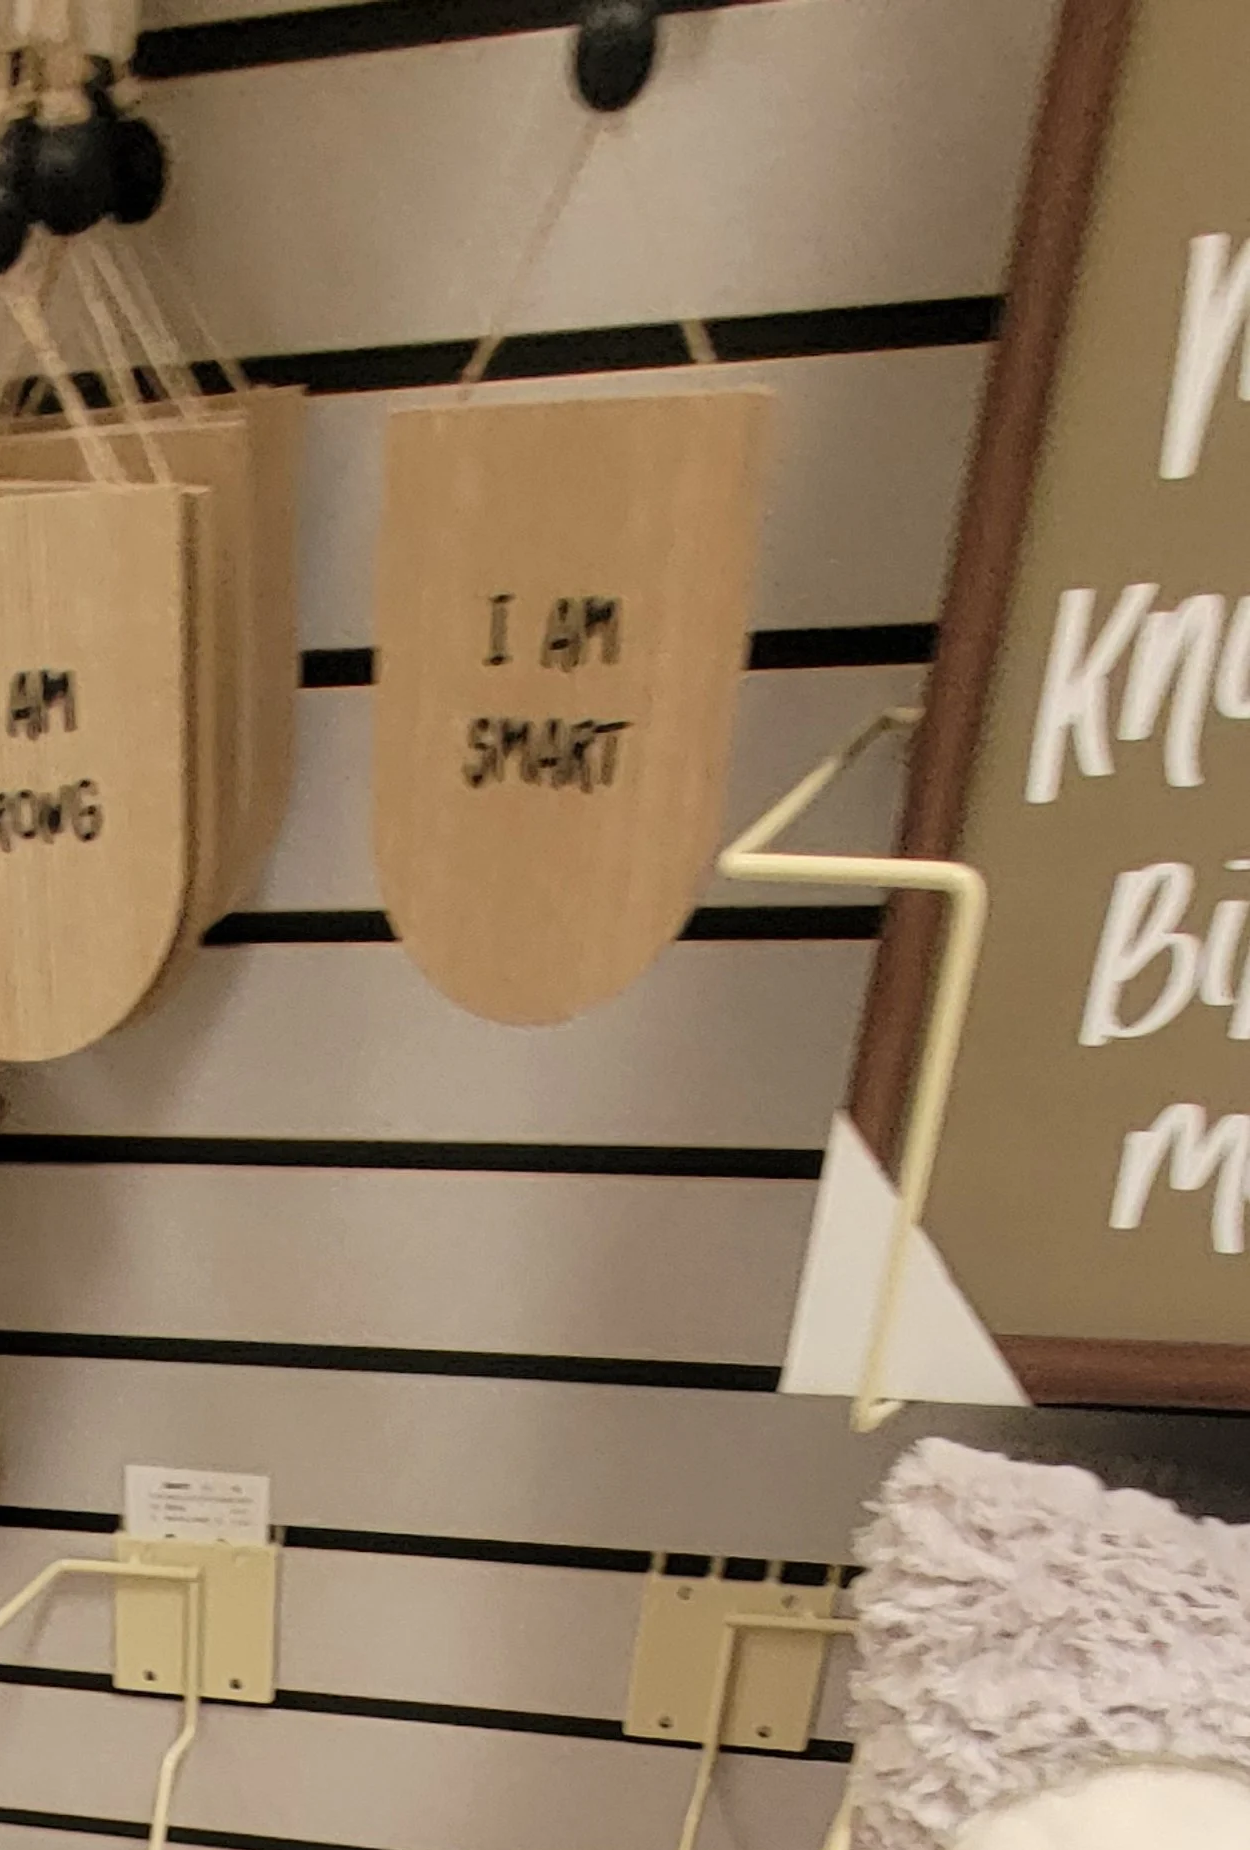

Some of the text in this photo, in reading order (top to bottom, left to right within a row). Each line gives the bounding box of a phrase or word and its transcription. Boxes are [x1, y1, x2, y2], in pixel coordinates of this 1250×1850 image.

[483, 594, 623, 670] I AM
[5, 669, 79, 740] AM
[462, 717, 632, 793] SMART
